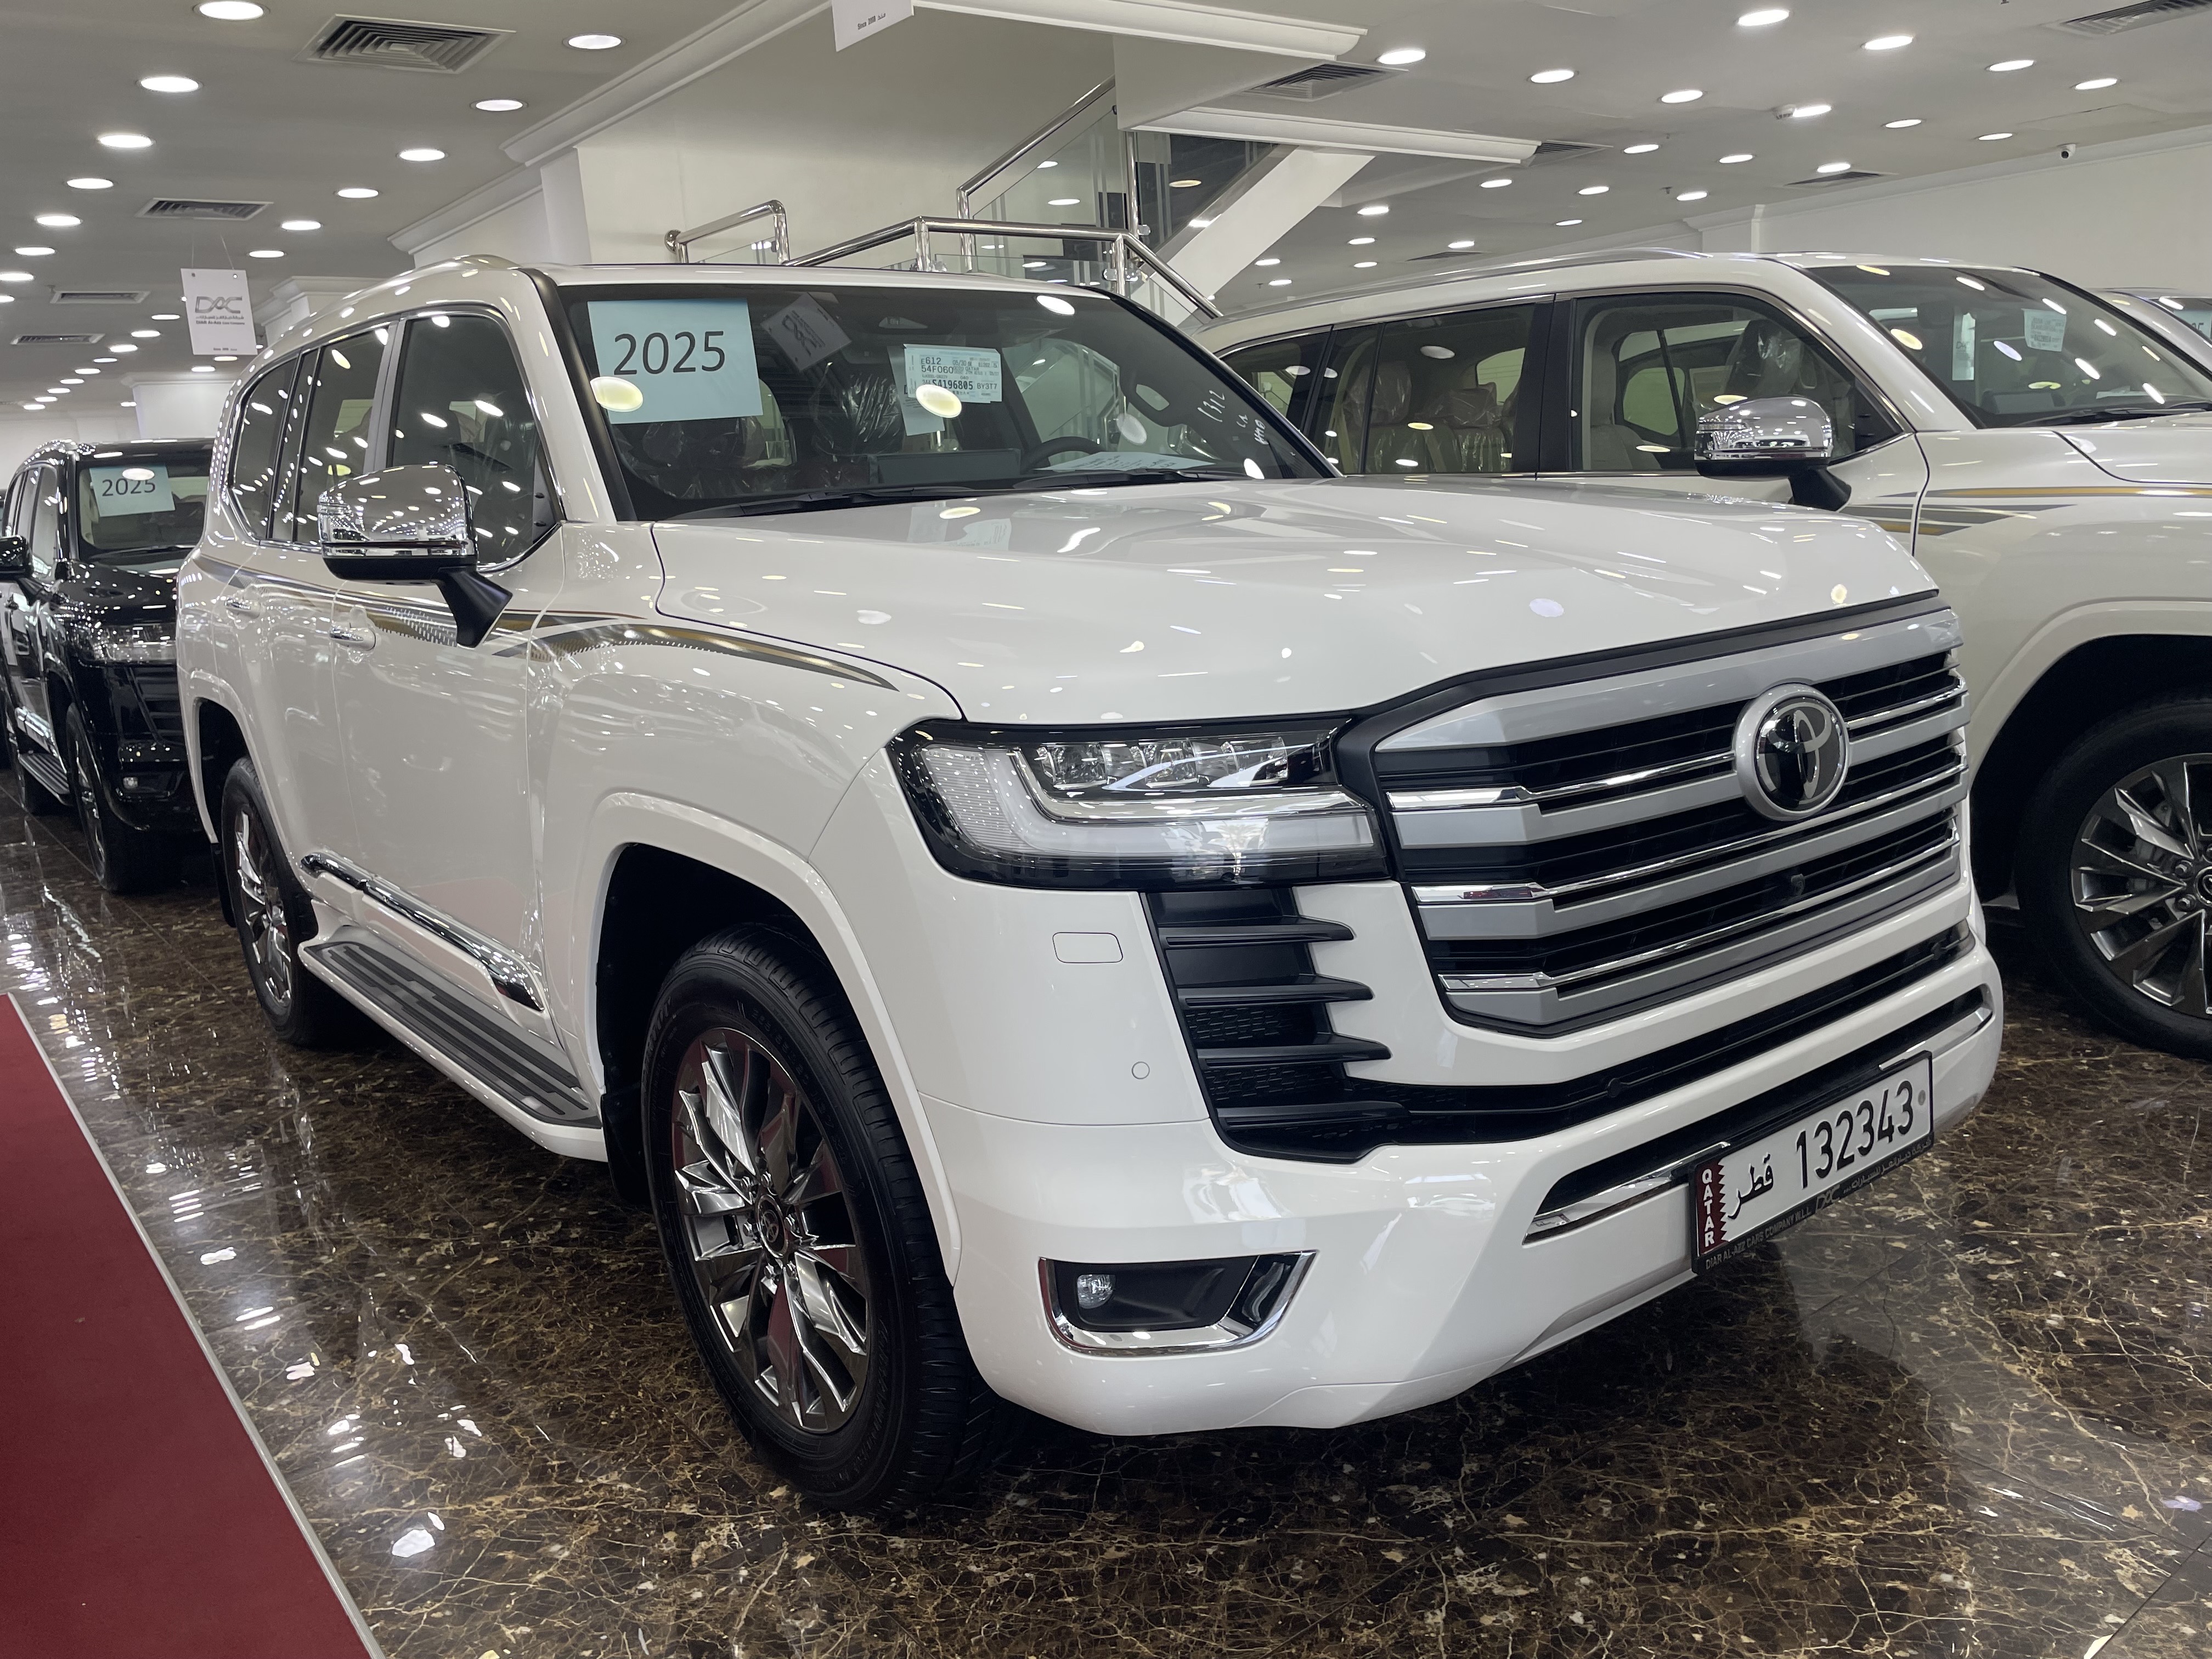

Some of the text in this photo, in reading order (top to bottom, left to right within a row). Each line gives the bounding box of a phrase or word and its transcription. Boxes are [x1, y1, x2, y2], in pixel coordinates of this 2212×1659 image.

[613, 330, 725, 375] 2025
[101, 478, 156, 496] 2025
[1796, 1080, 1914, 1189] 132343
[1702, 1169, 1714, 1247] QATAR
[1728, 1153, 1774, 1220] قطر
[1706, 1254, 1722, 1270] DIAR
[1747, 1232, 1764, 1248] CARS
[1765, 1214, 1794, 1238] COMPANY
